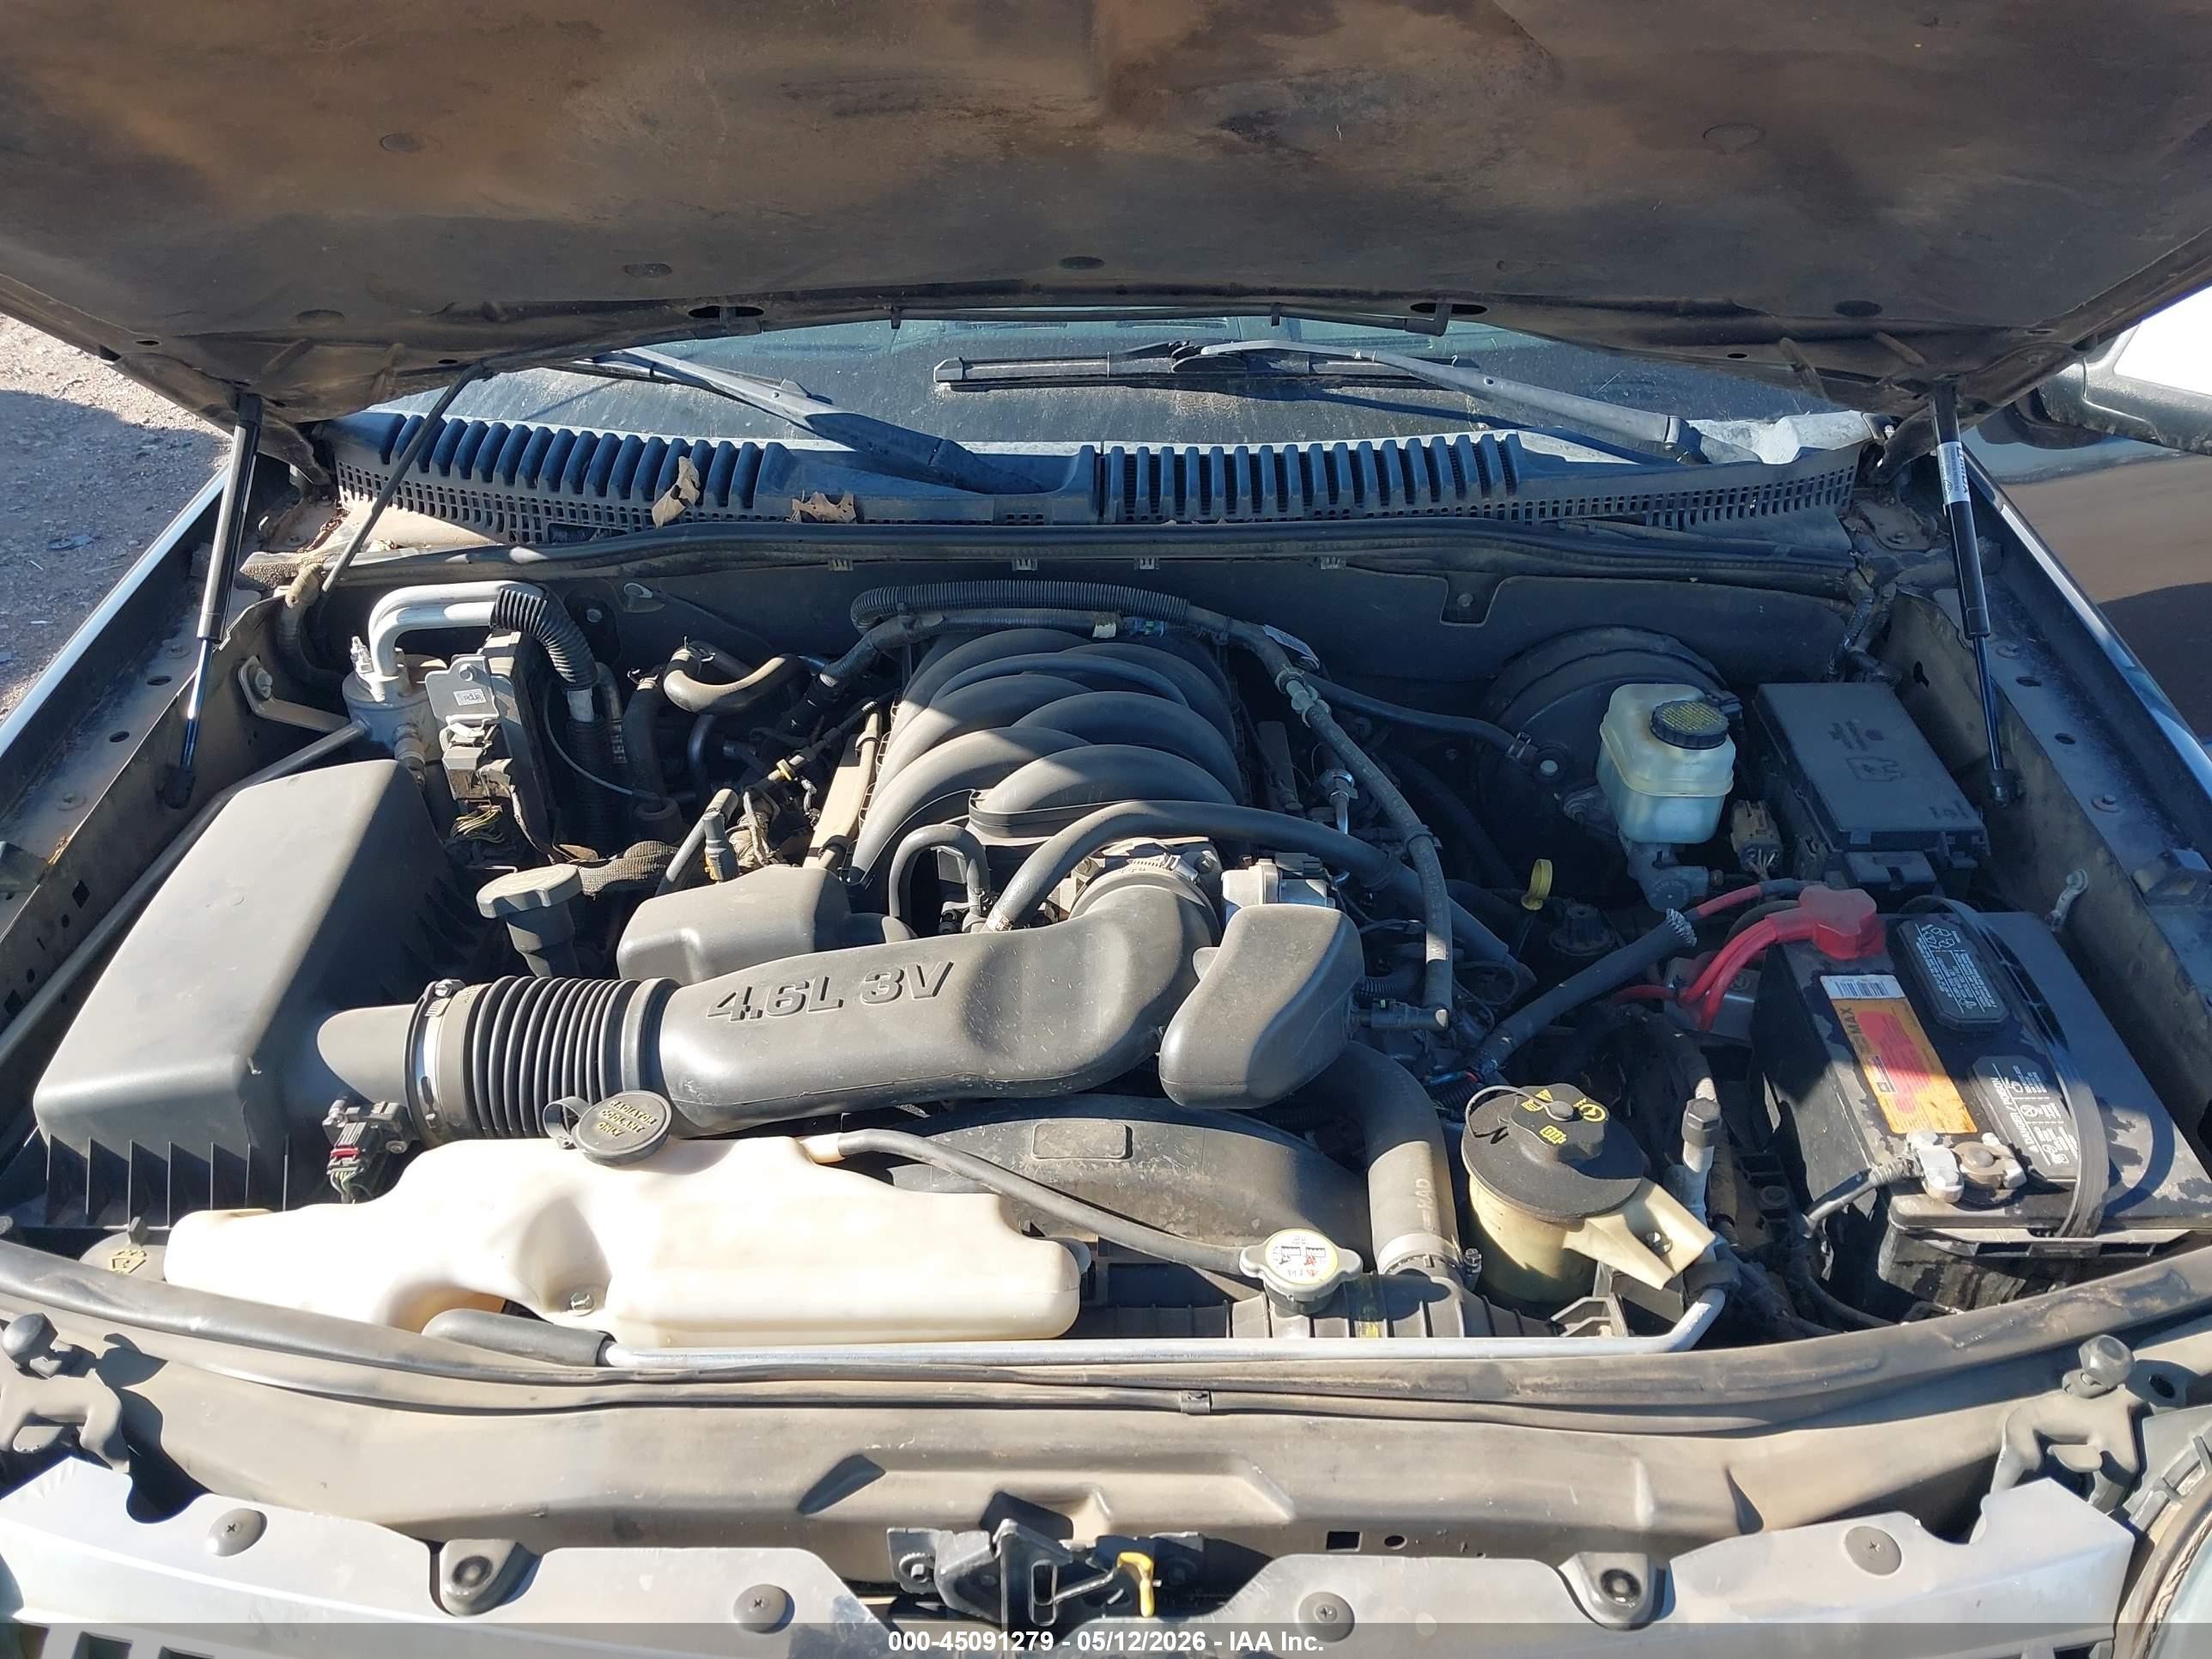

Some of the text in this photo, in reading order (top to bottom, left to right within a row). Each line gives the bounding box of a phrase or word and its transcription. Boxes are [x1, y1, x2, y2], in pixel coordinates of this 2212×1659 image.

[708, 961, 955, 1022] 4.6L 3V
[1990, 1077, 2014, 1106] POISON
[599, 1109, 646, 1133] COOLANT
[609, 1100, 658, 1127] RADIATOR
[598, 1121, 625, 1138] ONLY
[2009, 1112, 2036, 1146] DANGER
